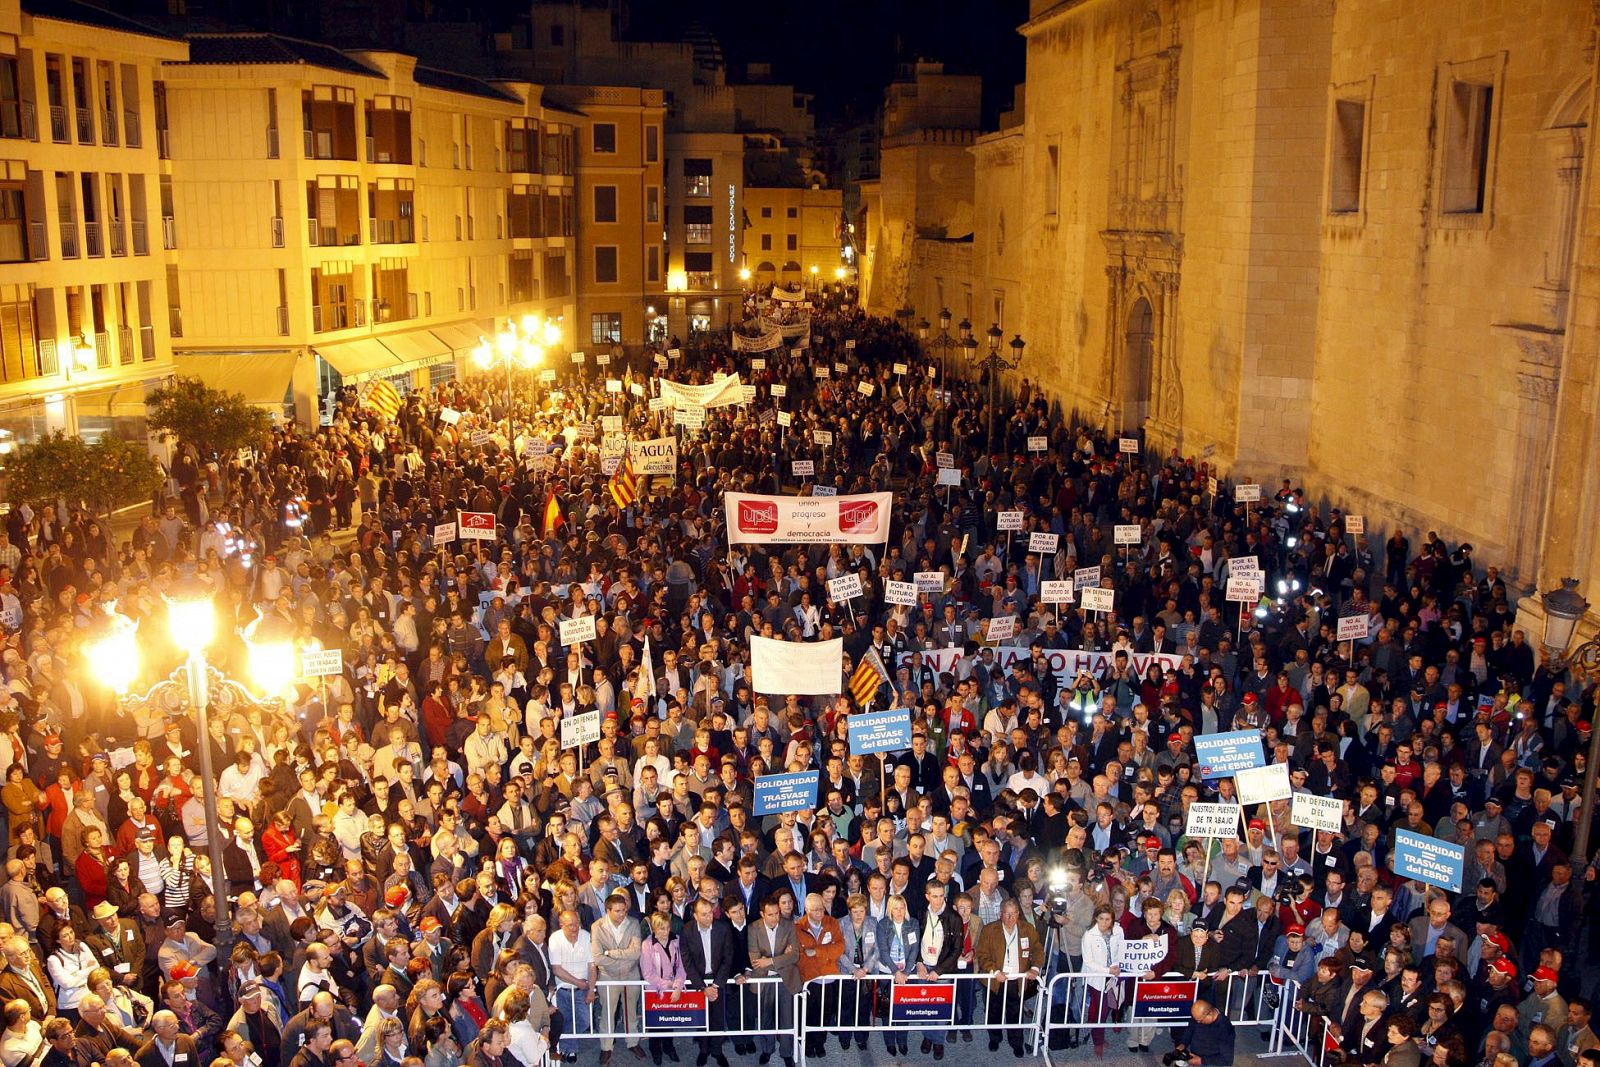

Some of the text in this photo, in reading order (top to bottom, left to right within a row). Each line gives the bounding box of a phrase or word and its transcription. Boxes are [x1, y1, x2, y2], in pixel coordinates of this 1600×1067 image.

[640, 445, 674, 456] AGUA
[792, 511, 826, 519] progreso
[834, 583, 858, 593] FUTURO
[843, 589, 862, 598] CAMPO
[564, 627, 584, 636] ESTATUTO
[573, 714, 598, 726] DEFENSA
[849, 714, 909, 729] SOLIDARIDAD
[576, 726, 585, 734] DEL
[858, 730, 904, 741] TRASVASE
[861, 738, 901, 749] del EBRO
[1196, 736, 1260, 750] SOLIDARIDAD
[1207, 752, 1256, 764] TRASVASE
[1212, 761, 1254, 772] del EBRO
[756, 776, 818, 789] SOLIDARIDAD
[762, 791, 810, 802] TRASVASE
[765, 799, 805, 810] del EBRO
[1309, 798, 1340, 809] DEFENSA
[1191, 805, 1238, 814] NUESTROS PUESTOS
[1311, 808, 1324, 817] DEL
[1396, 835, 1462, 860] SOLIDARIDAD
[1404, 854, 1454, 875] TRASVASE
[1406, 864, 1449, 883] del EBRO
[1124, 950, 1164, 960] FUTURO
[1119, 962, 1133, 970] DEL
